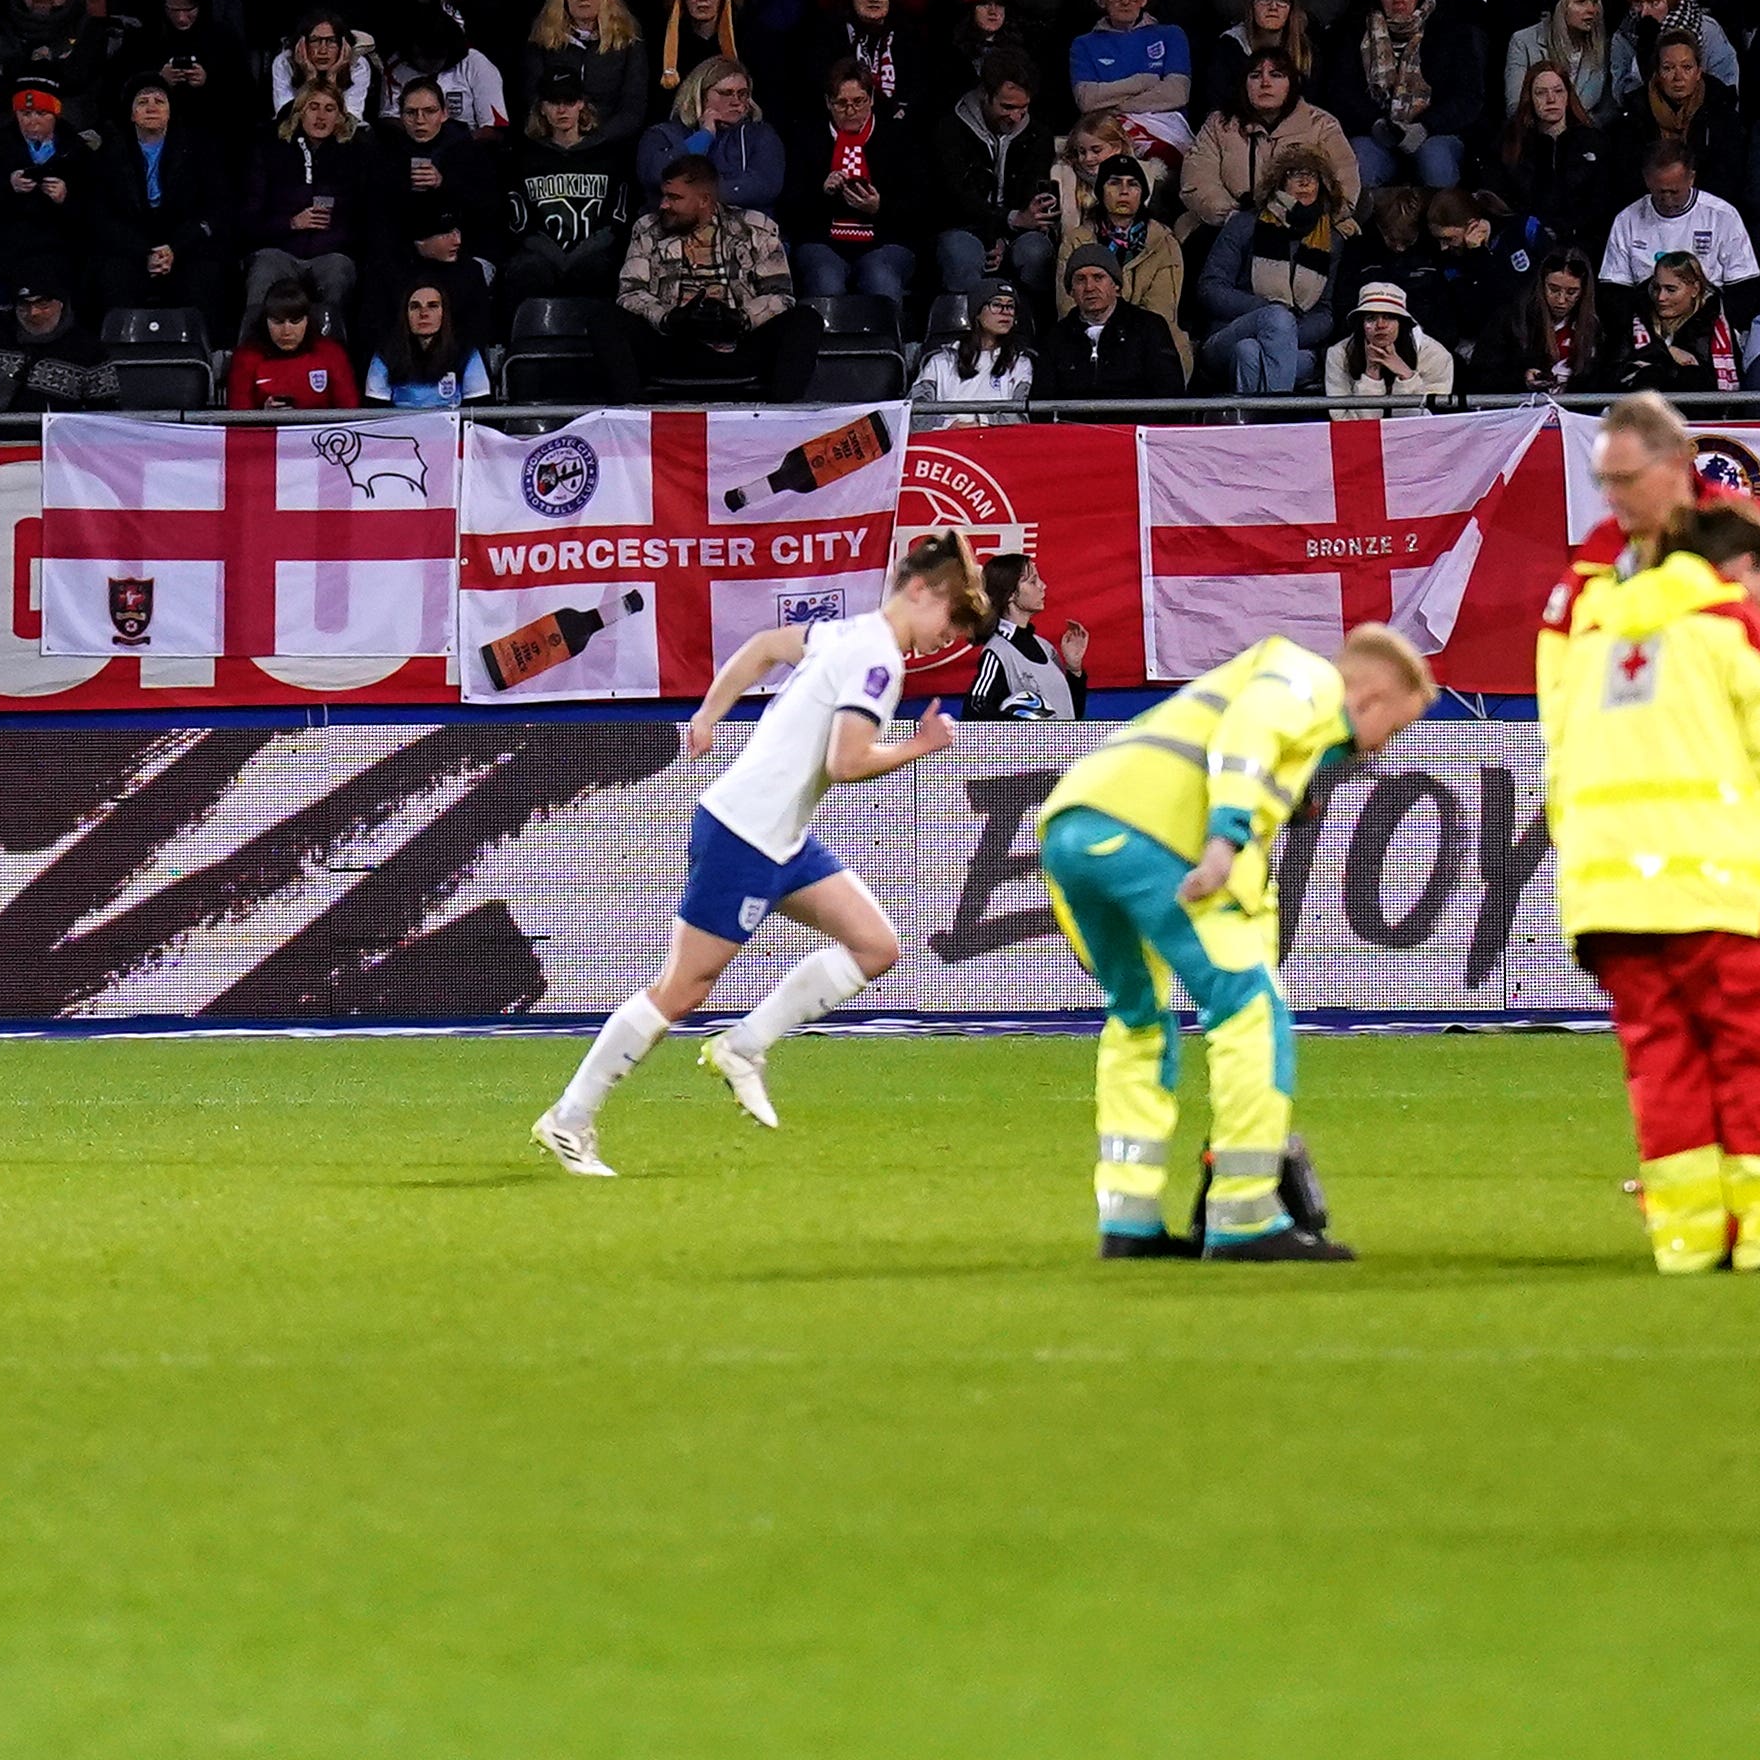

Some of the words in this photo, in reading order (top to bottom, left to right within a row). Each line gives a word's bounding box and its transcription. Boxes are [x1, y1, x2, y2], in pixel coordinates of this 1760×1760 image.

[524, 173, 609, 202] BROOKLYN
[914, 459, 997, 520] BELGIAN
[488, 535, 756, 577] WORCESTER
[769, 526, 869, 565] CITY
[1305, 532, 1394, 558] BRONZE
[1404, 531, 1419, 555] 2
